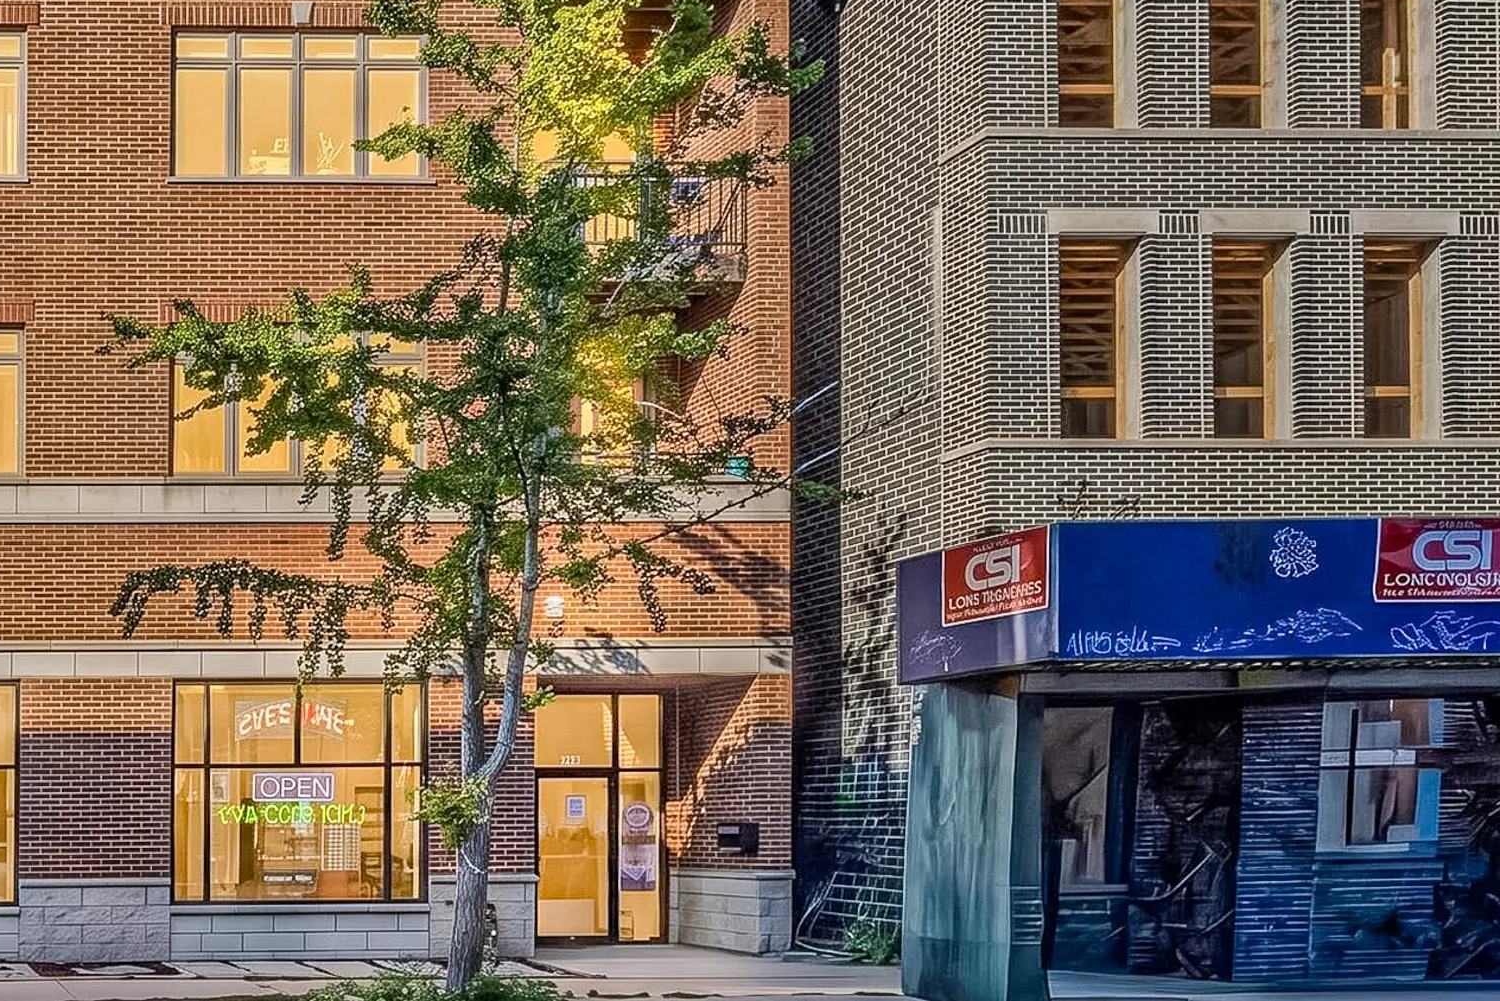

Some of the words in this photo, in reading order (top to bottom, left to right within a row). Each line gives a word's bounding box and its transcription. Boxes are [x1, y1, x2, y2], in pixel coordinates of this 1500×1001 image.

[965, 543, 1020, 591] CSI
[1412, 529, 1493, 571] CSI
[260, 776, 330, 798] OPEN
